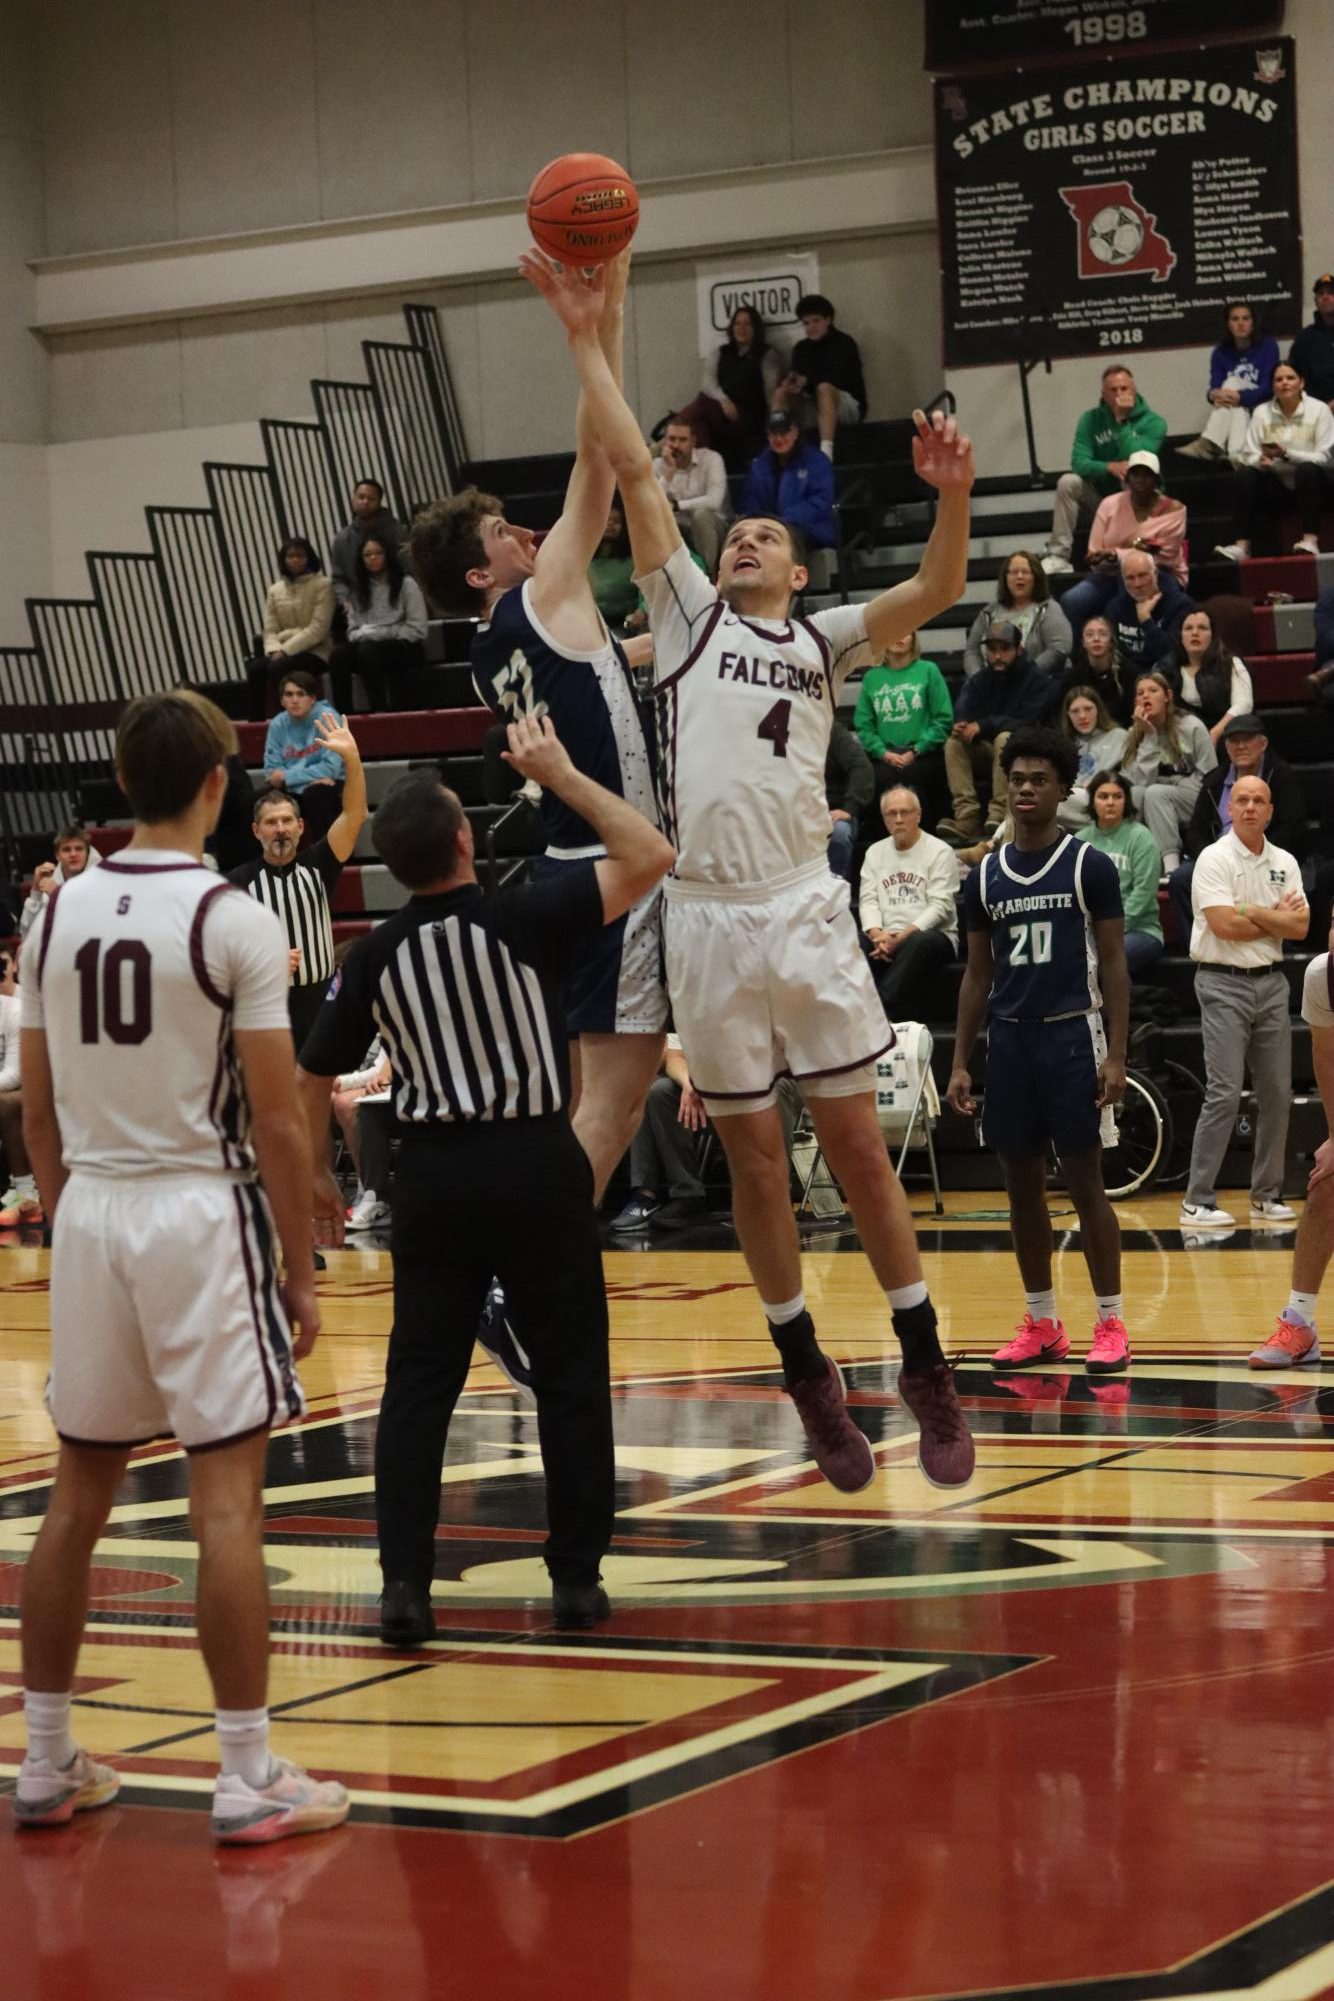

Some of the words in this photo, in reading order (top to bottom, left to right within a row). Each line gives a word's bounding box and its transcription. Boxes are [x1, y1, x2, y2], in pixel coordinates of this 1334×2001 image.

[1064, 10, 1147, 46] 1998
[952, 94, 1053, 159] STATE
[1063, 79, 1278, 122] CHAMPIONS
[1024, 122, 1097, 151] GIRLS
[1102, 110, 1206, 143] SOCCER
[1116, 149, 1157, 160] Soccer
[571, 197, 630, 216] LEGACY
[722, 287, 791, 319] VISITOR
[1099, 328, 1143, 346] 2018
[718, 651, 824, 701] FALCONS
[757, 699, 792, 758] 4
[882, 872, 926, 889] DETROIT
[989, 893, 1073, 921] MARQUETTE
[1010, 922, 1052, 967] 20
[74, 938, 153, 1045] 10
